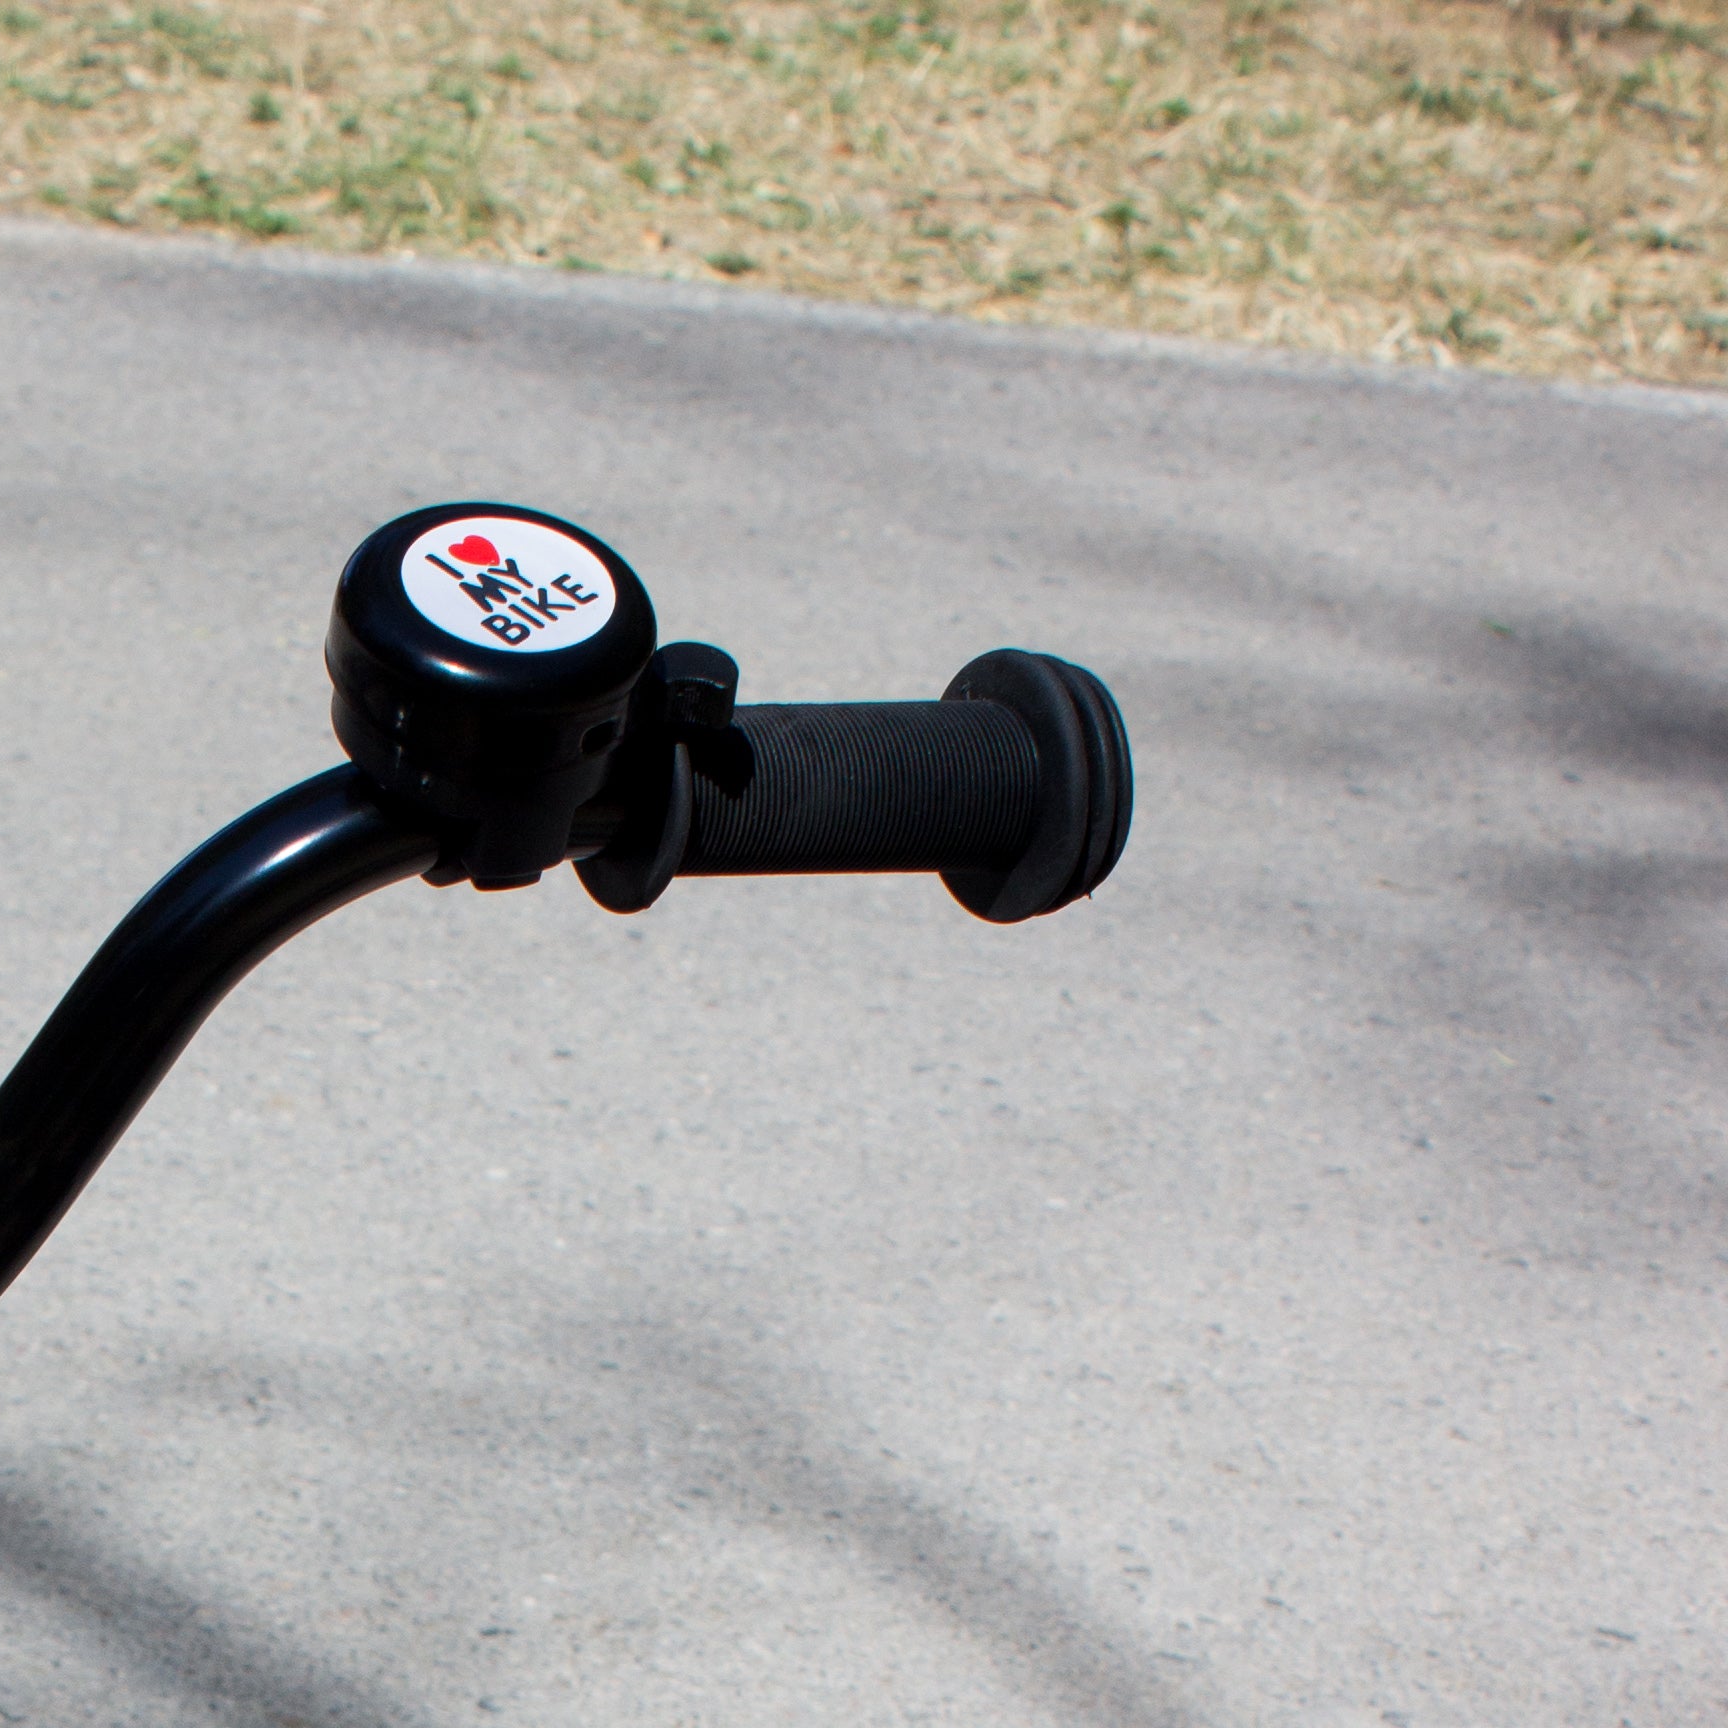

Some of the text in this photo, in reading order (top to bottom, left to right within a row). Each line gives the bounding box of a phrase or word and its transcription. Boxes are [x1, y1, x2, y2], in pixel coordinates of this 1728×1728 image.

[425, 553, 466, 579] I
[459, 559, 533, 618] MY
[481, 574, 598, 645] BIKE
